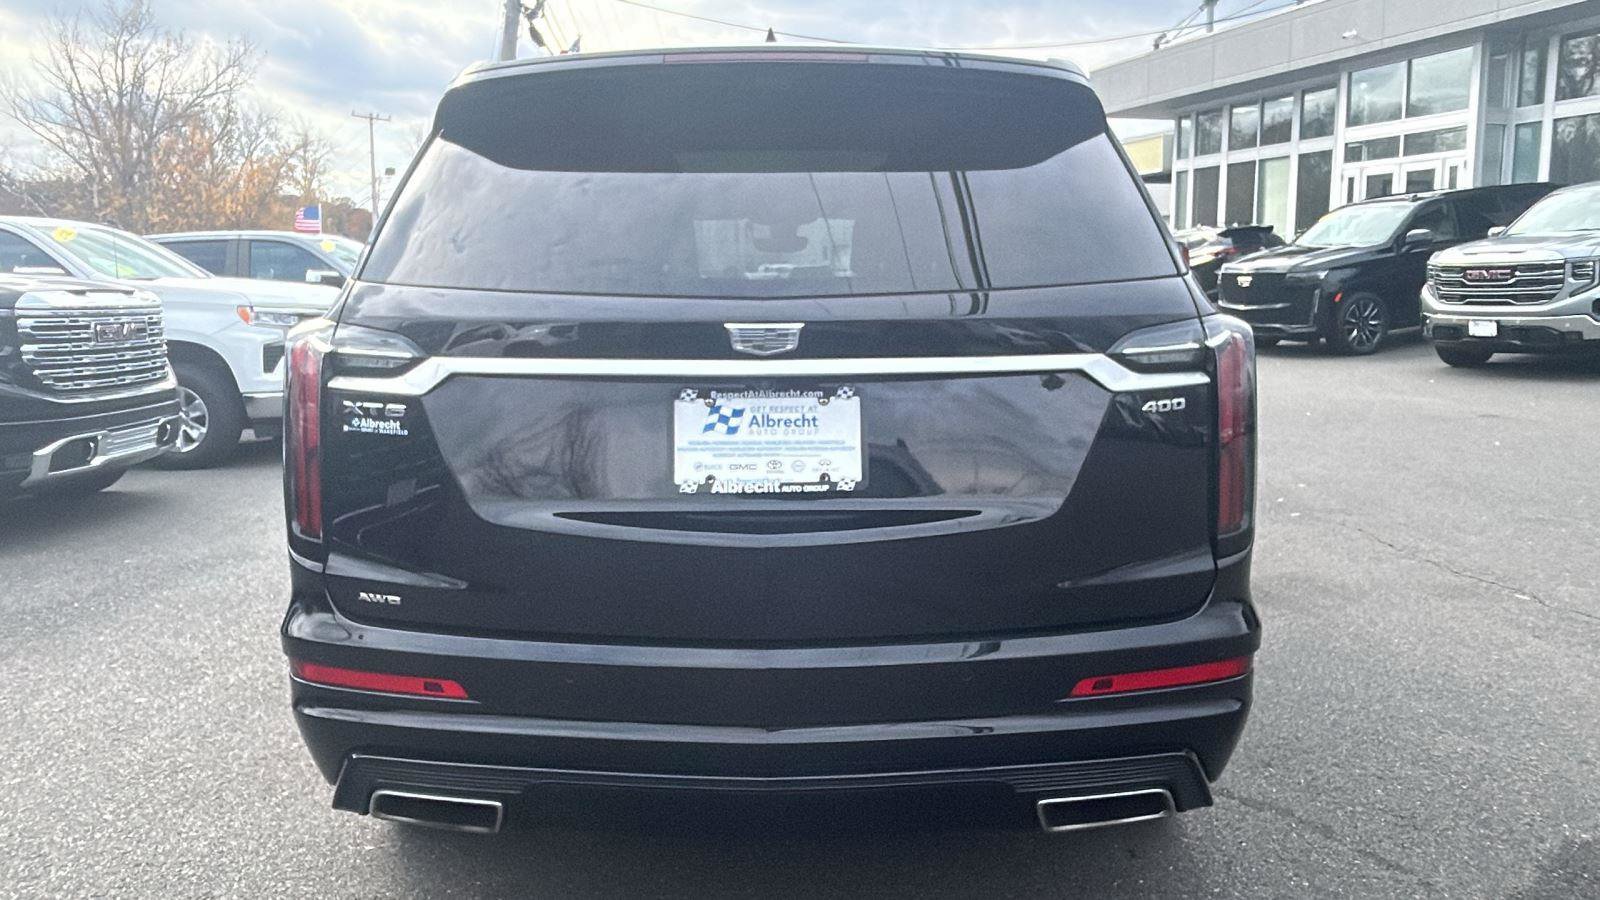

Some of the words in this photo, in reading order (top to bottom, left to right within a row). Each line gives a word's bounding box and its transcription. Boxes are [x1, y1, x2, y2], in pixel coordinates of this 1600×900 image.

[1466, 269, 1511, 279] GMC
[711, 390, 824, 400] RespectAtAlbrecht.com
[343, 401, 407, 417] XT6
[1141, 397, 1186, 413] 400
[360, 417, 401, 430] Albrecht
[749, 414, 819, 428] Albrecht
[710, 479, 781, 493] Albrecht
[358, 592, 401, 604] AWD
